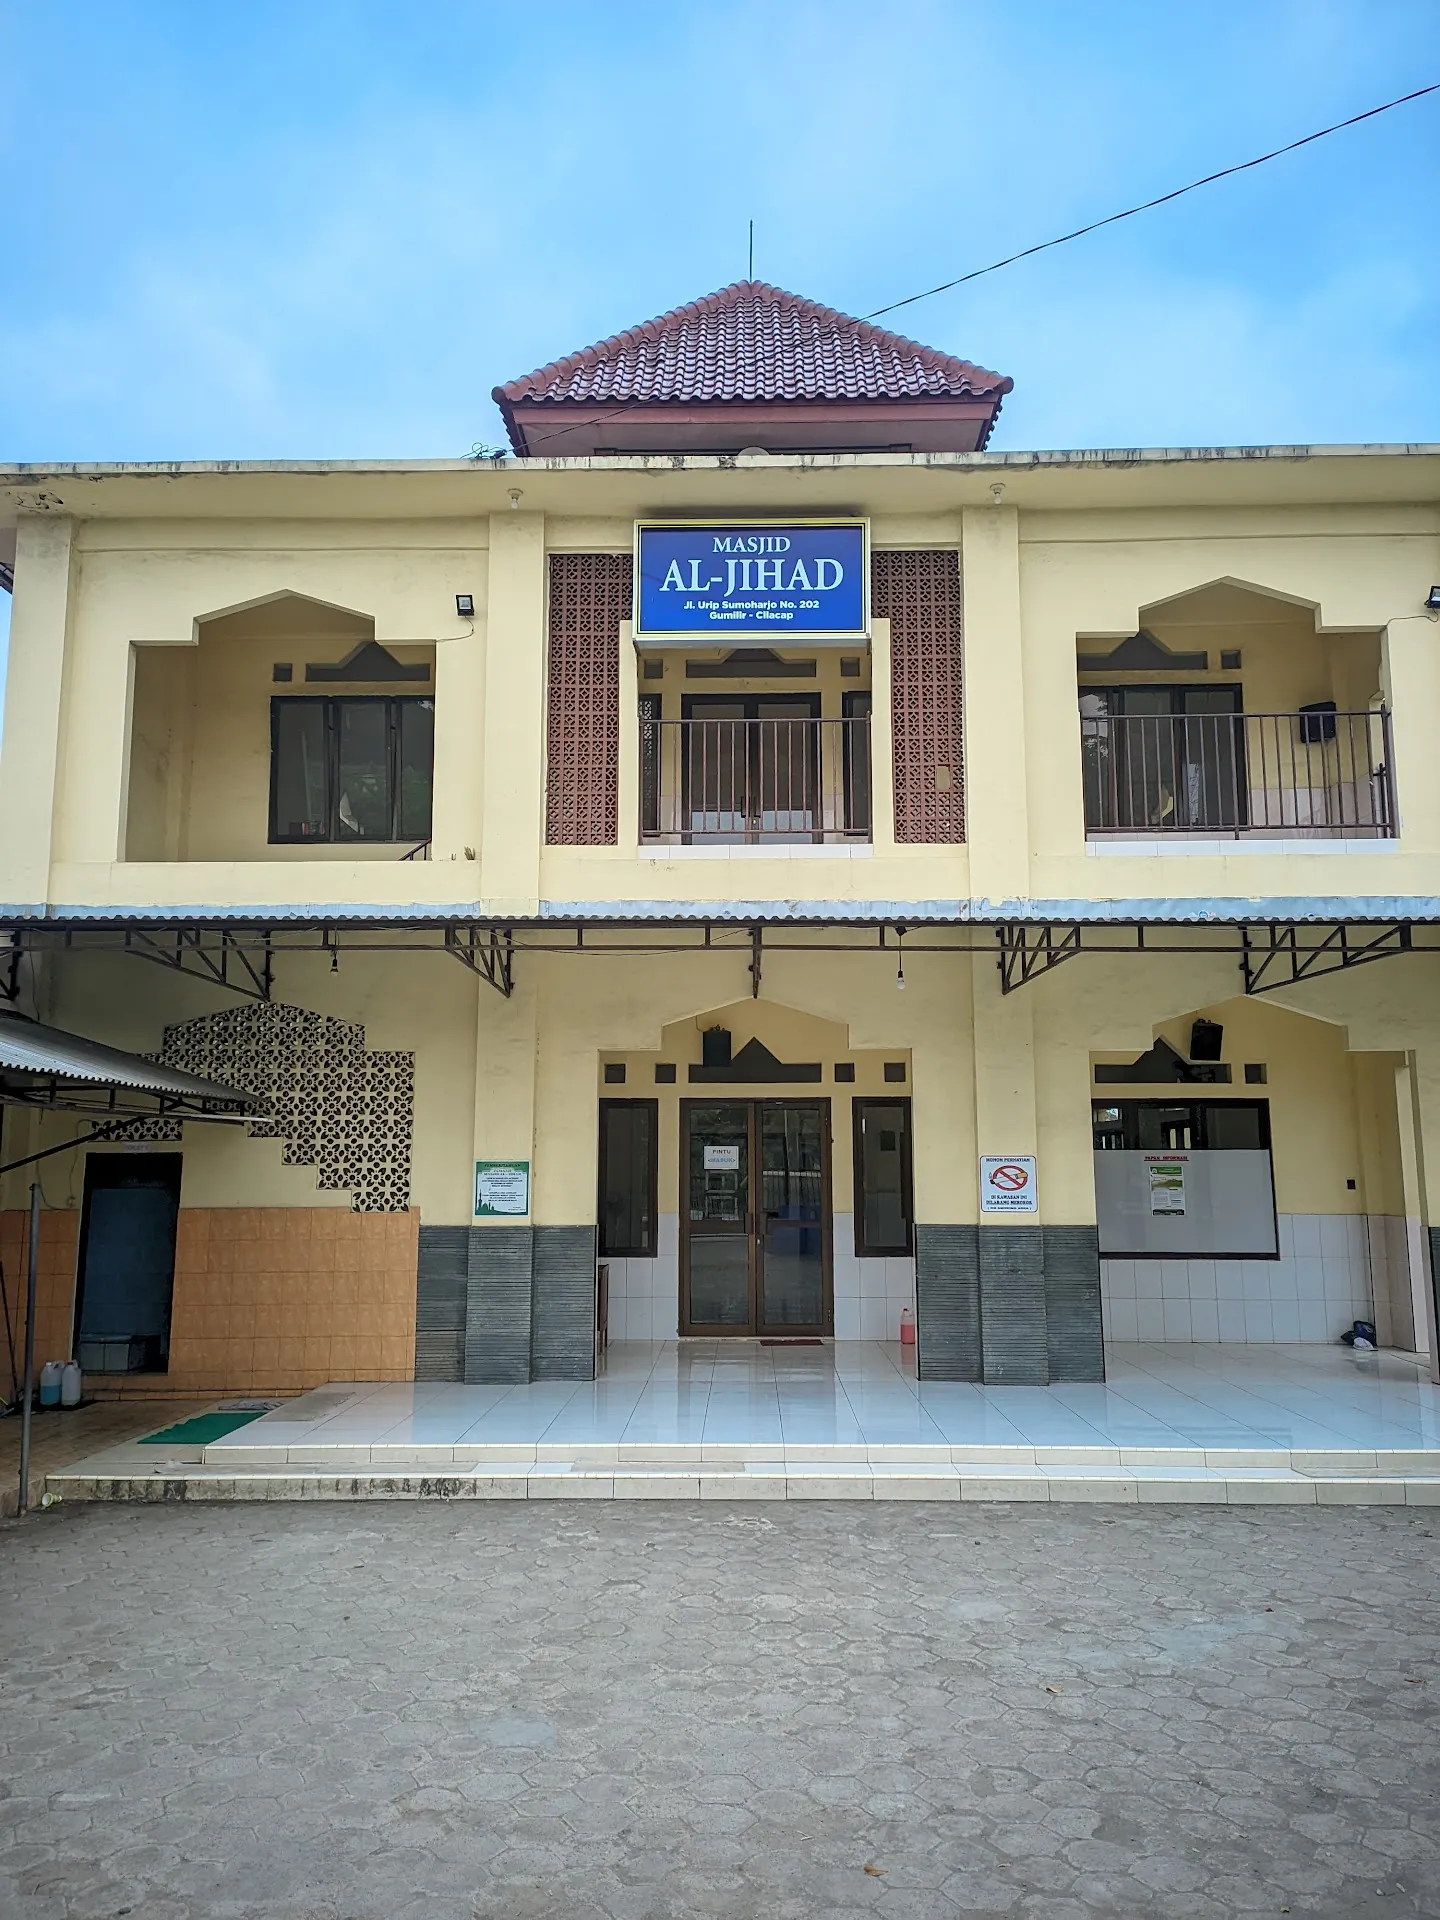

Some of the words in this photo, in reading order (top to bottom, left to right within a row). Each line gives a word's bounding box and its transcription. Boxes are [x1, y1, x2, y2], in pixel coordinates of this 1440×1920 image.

[712, 536, 791, 555] MASJID
[659, 558, 844, 597] AL-JIHAD
[683, 601, 696, 610] Jl.
[697, 601, 720, 610] Urip
[721, 601, 778, 610] Sumoharjo
[779, 601, 797, 609] No.
[799, 600, 820, 609] 202
[709, 611, 747, 620] Gumilir
[755, 611, 794, 620] Cilacap
